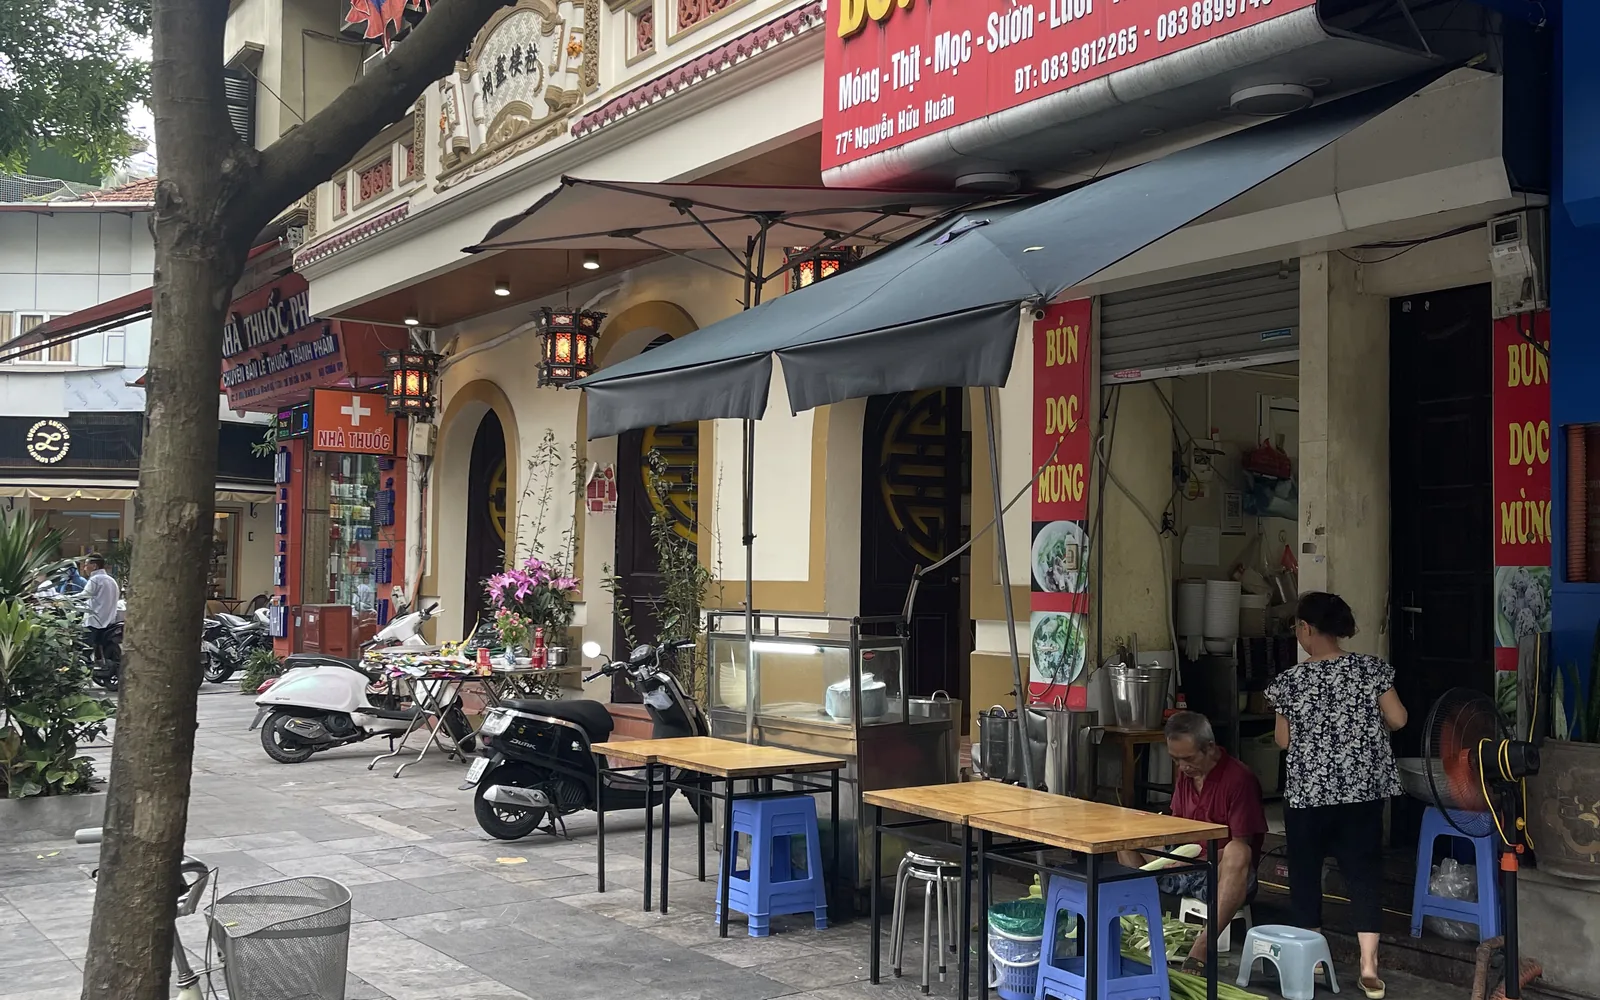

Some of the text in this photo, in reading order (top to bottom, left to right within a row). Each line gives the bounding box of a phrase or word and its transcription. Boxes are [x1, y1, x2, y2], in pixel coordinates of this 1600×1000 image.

[838, 67, 880, 112] Móng
[891, 44, 921, 92] Thịt
[934, 29, 972, 76] Mọc
[987, 0, 1034, 53] Sườn
[1014, 64, 1038, 94] ĐT:
[854, 112, 894, 149] Nguyễn
[898, 104, 920, 134] Hữu
[924, 93, 955, 124] Huân
[243, 291, 289, 348] THUỐC
[289, 290, 315, 330] PH
[1046, 316, 1079, 367] BÚN
[317, 426, 390, 450] NHÀ THUỐC
[1045, 394, 1078, 443] DỌC
[1508, 420, 1550, 476] DỌC
[1037, 453, 1084, 503] MÙNG
